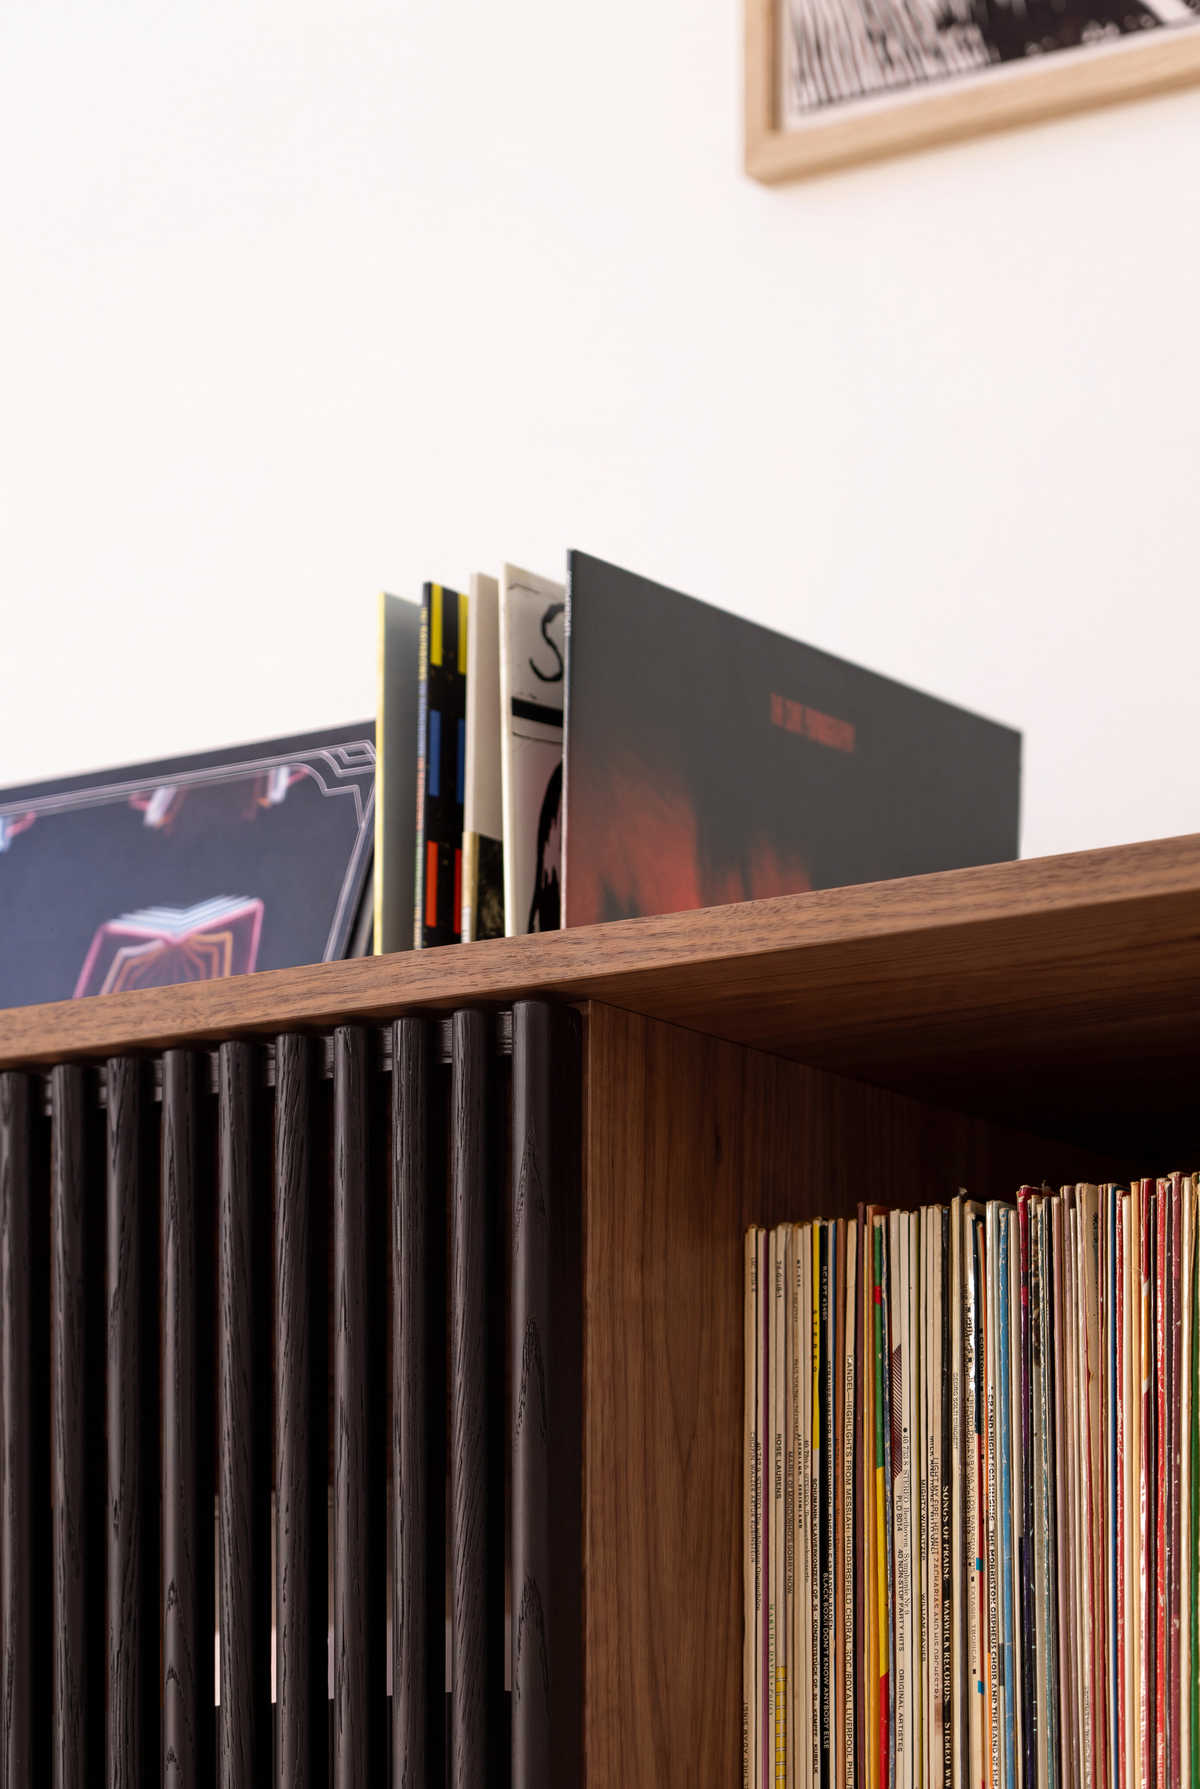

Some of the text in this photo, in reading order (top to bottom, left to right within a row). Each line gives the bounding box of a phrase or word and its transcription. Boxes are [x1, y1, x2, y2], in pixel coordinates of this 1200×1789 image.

[822, 1285, 828, 1296] PT
[903, 1434, 909, 1444] 40
[933, 1485, 939, 1497] MY
[943, 1526, 950, 1539] OF
[897, 1549, 903, 1559] 40
[902, 1553, 910, 1596] Symphonie
[993, 1756, 998, 1766] OF
